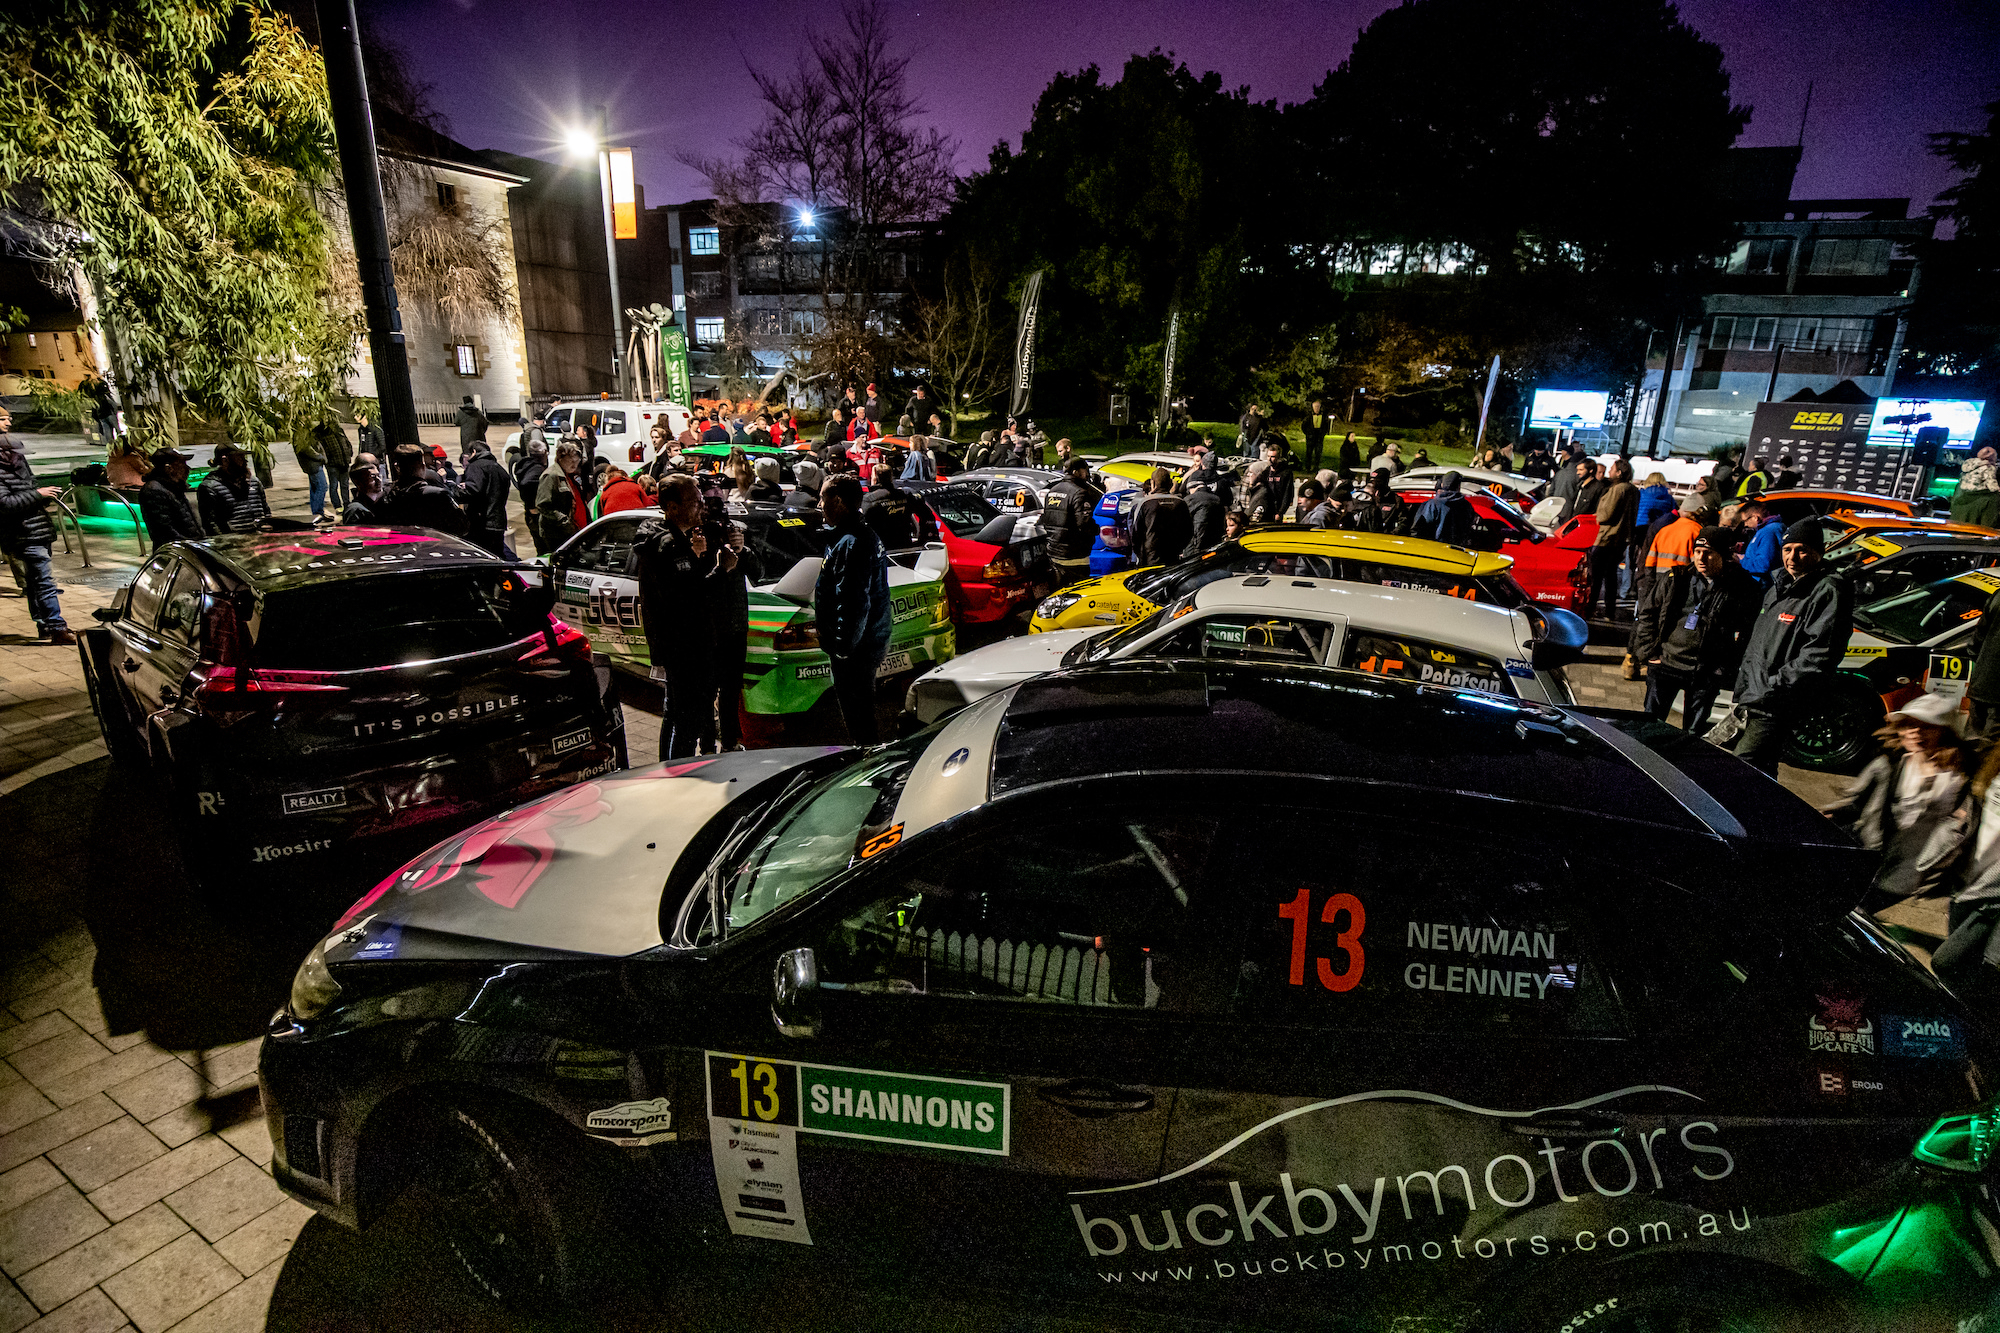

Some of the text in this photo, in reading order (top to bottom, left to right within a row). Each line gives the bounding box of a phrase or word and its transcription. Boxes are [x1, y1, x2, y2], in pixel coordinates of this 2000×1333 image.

[1020, 306, 1034, 388] buckbymotors
[1793, 411, 1843, 425] RSEA
[1015, 489, 1025, 506] 6
[1421, 664, 1500, 693] Peterson
[1941, 657, 1962, 680] 19
[354, 695, 526, 737] IT'S POSSIBLE.
[557, 733, 587, 749] REALTY
[290, 793, 337, 808] REALTY
[252, 839, 331, 862] Hoosier
[1279, 888, 1366, 992] 13
[1407, 921, 1555, 960] NEWMAN
[1404, 962, 1552, 1000] GLENNEY
[1809, 1030, 1836, 1045] HOGS
[1824, 1041, 1860, 1053] CAFE
[1839, 1031, 1874, 1051] BREATH
[731, 1060, 780, 1121] 13
[1852, 1080, 1883, 1090] EROAD
[810, 1083, 995, 1133] SHANNONS
[590, 1115, 667, 1130] motorsport
[743, 1127, 780, 1139] Tasmania
[747, 1179, 783, 1189] elysian
[1070, 1121, 1735, 1257] buckbymotors
[1098, 1207, 1750, 1283] www.buckbymotors.com.au
